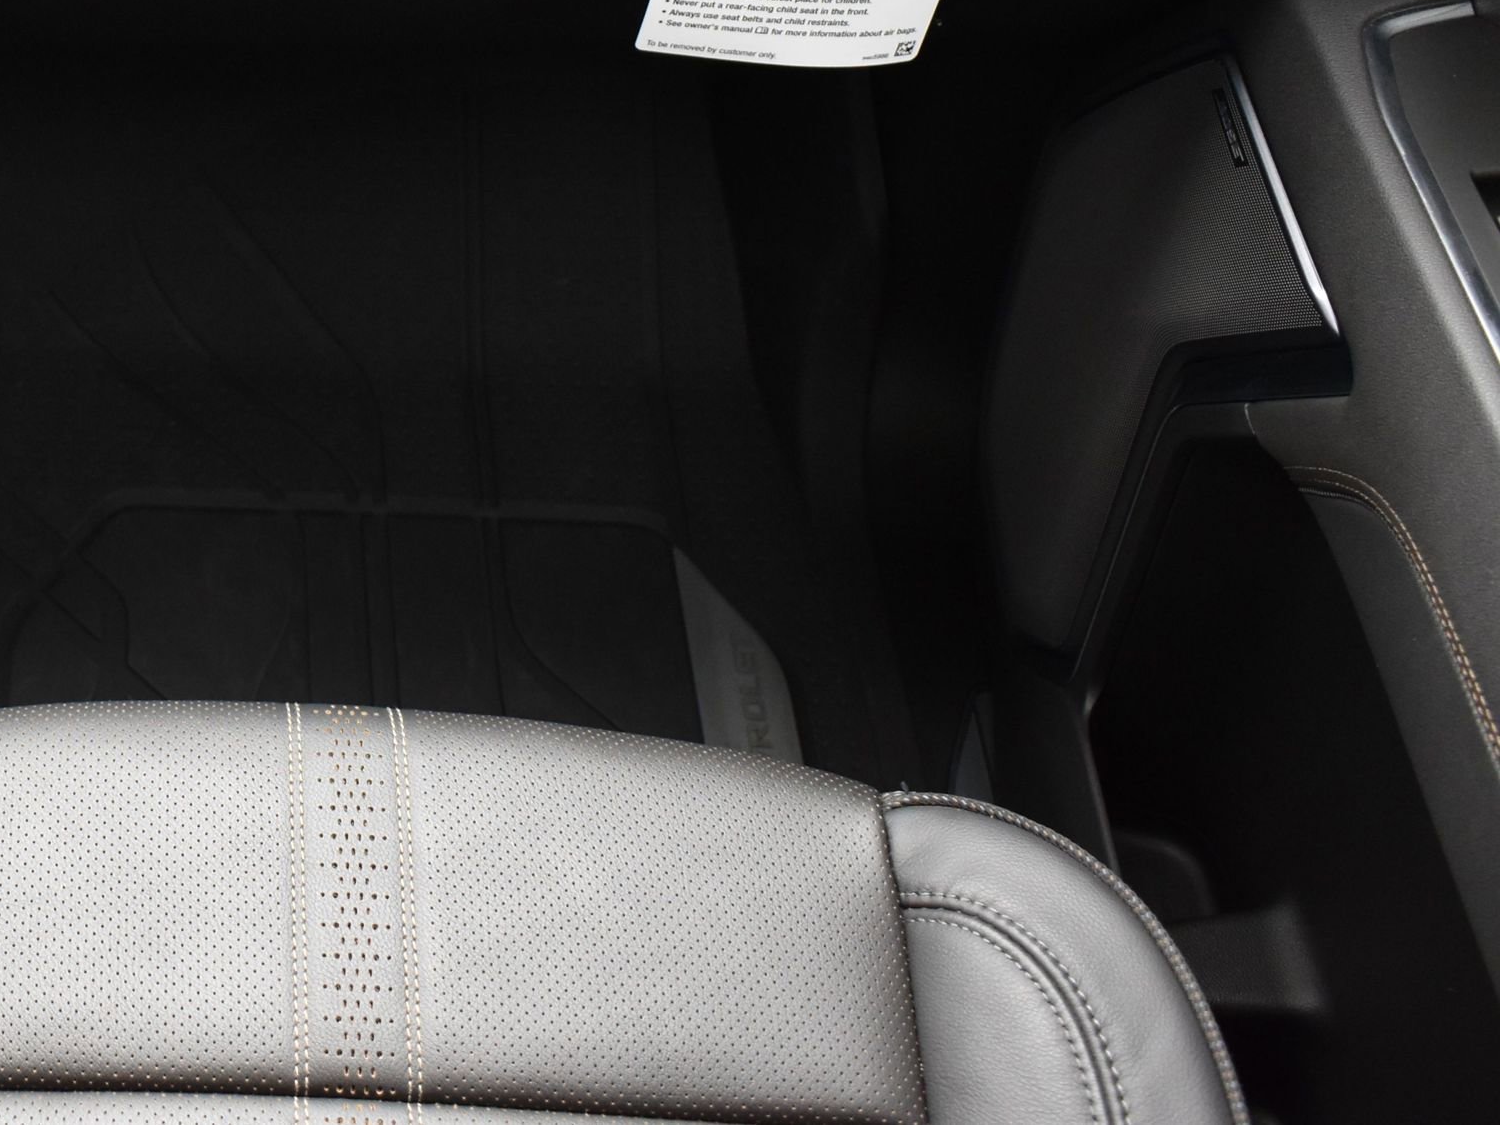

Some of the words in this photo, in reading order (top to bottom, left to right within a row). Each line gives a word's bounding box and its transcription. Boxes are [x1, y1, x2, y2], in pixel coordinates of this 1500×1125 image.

[700, 1, 715, 9] put
[725, 3, 774, 13] rear-facing
[777, 5, 797, 13] child
[669, 9, 701, 19] Always
[742, 15, 763, 23] belts
[766, 16, 782, 24] and
[785, 17, 805, 25] child
[808, 18, 850, 26] restraints.
[666, 19, 682, 27] See
[685, 22, 718, 31] owner's
[721, 24, 753, 33] manual
[771, 28, 782, 36] for
[810, 29, 857, 37] information
[859, 29, 882, 37] about
[884, 28, 894, 36] air
[897, 27, 916, 35] bags.
[670, 43, 705, 52] removed
[707, 45, 718, 54] by
[719, 47, 756, 58] customer
[758, 51, 776, 59] only.
